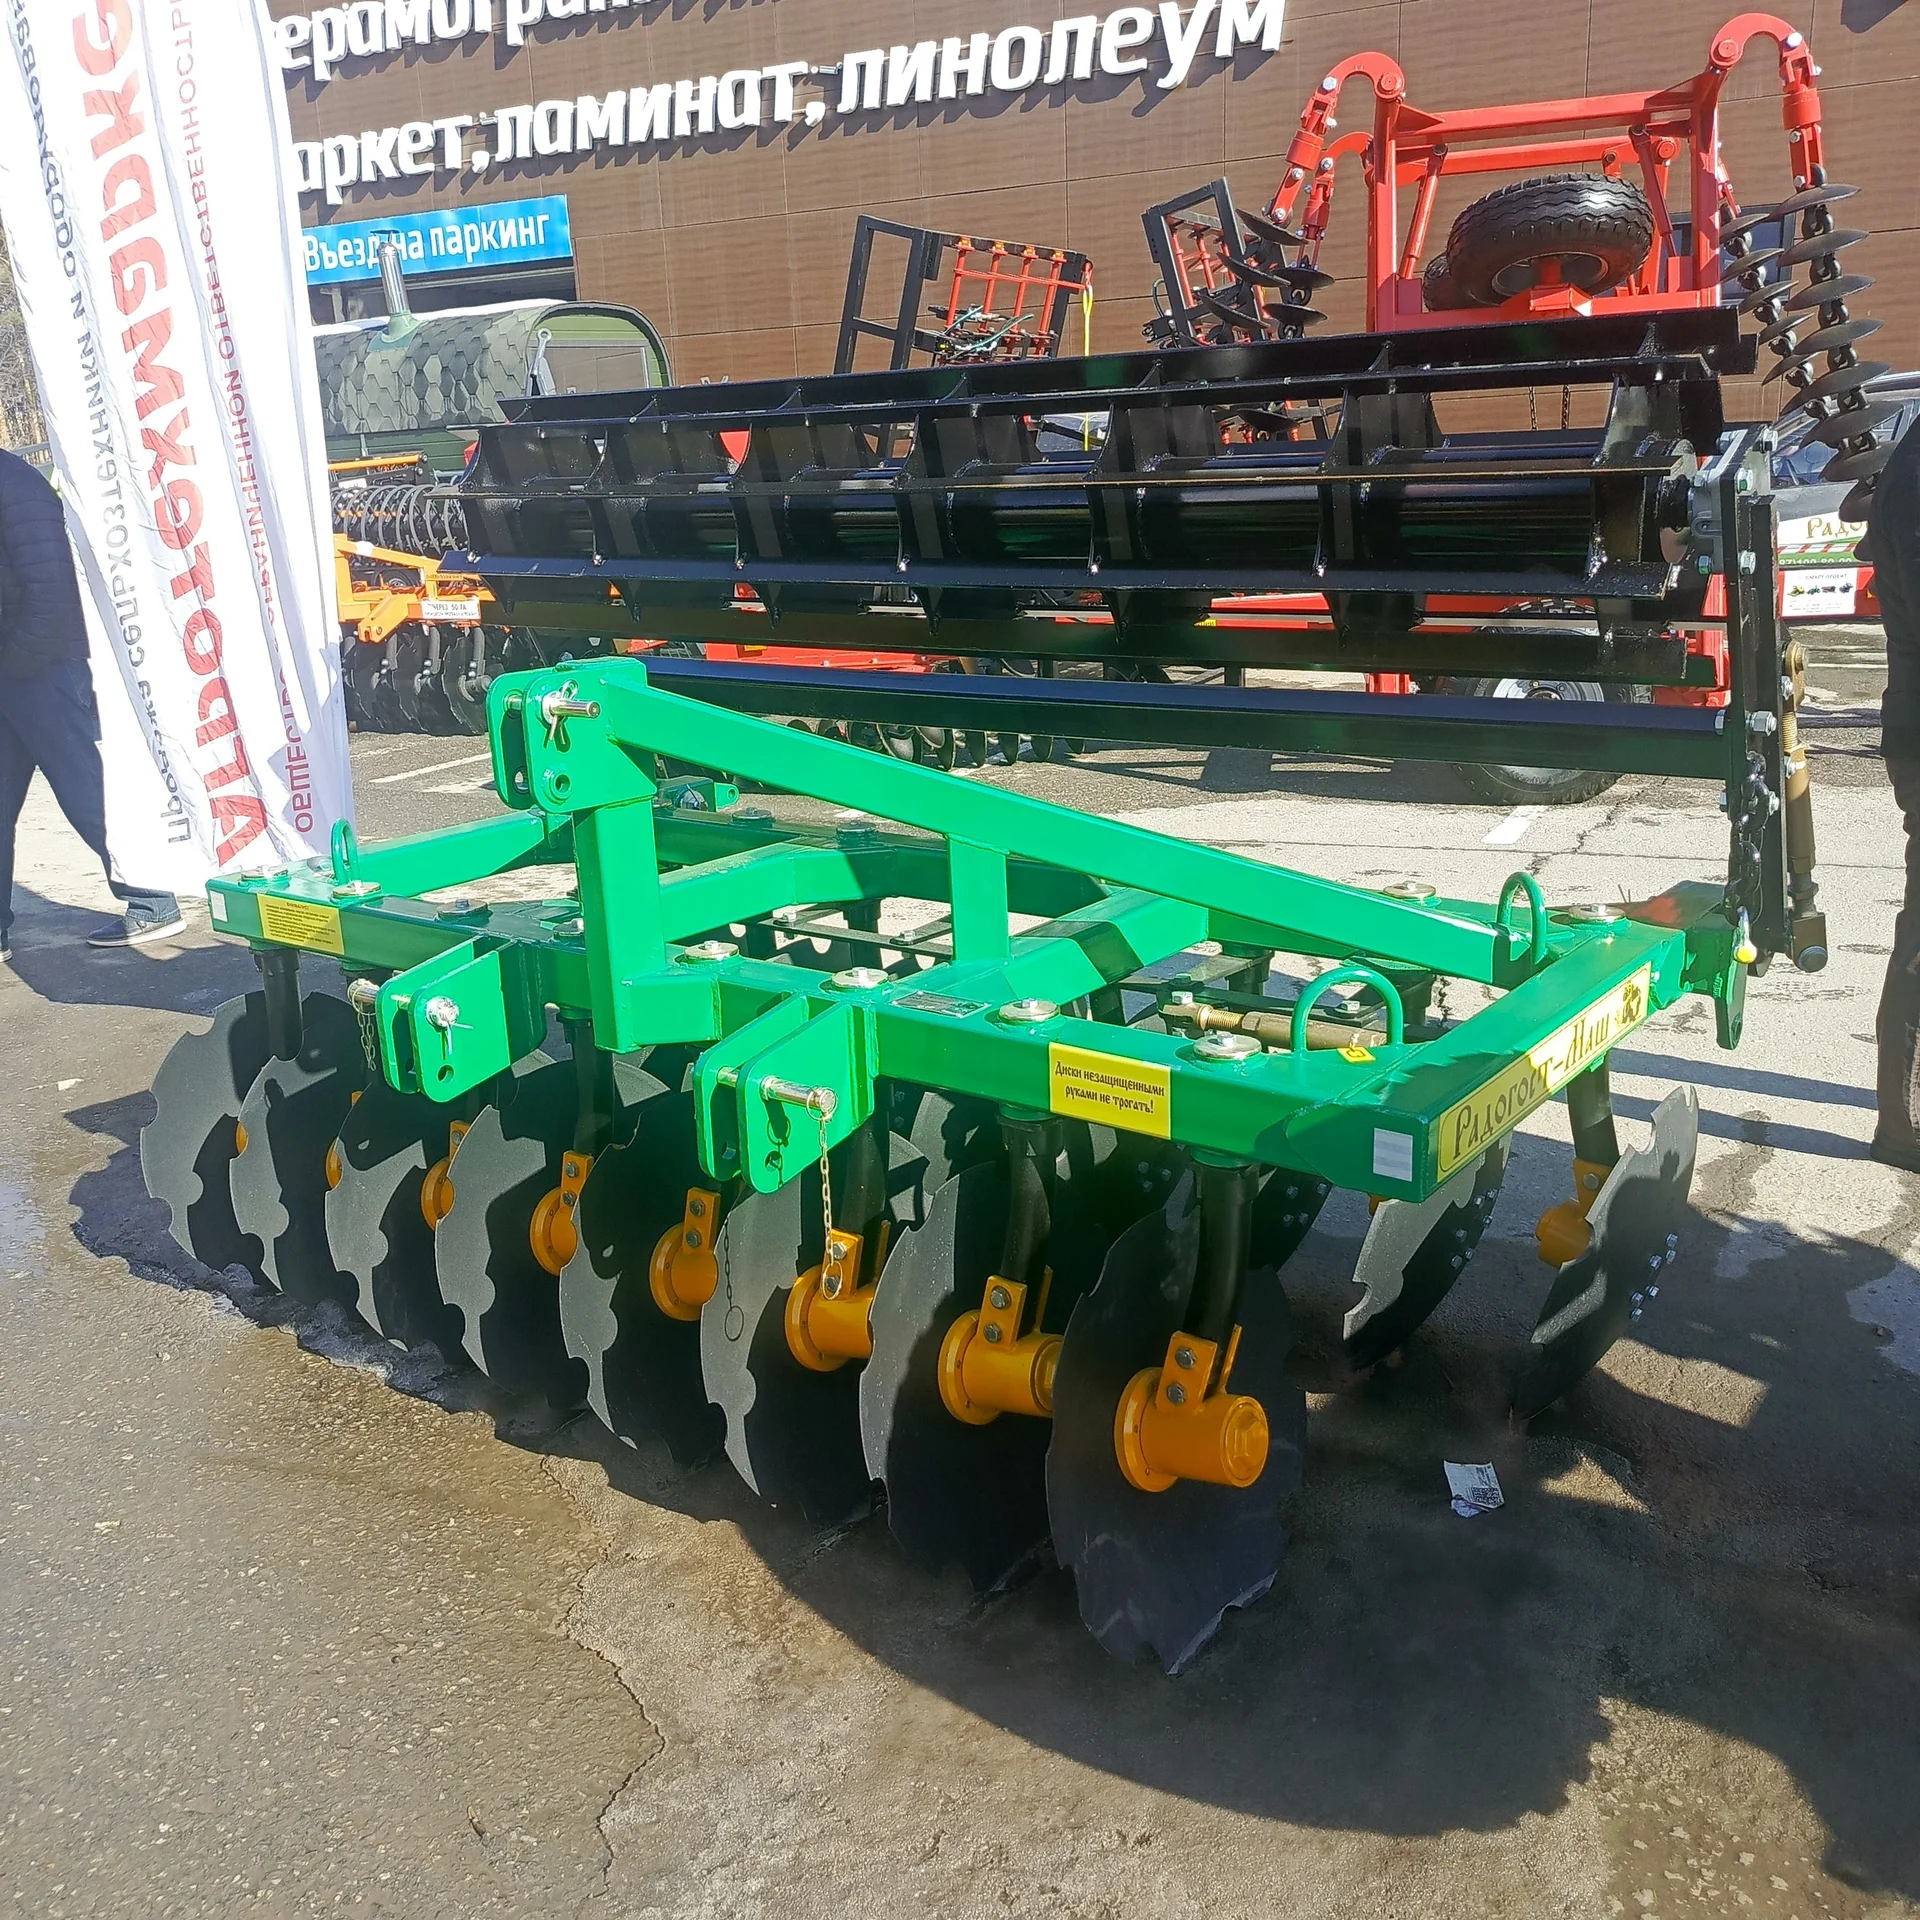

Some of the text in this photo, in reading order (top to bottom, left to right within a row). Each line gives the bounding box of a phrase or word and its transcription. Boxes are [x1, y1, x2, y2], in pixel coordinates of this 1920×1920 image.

[272, 0, 652, 81] ерамогр
[836, 0, 1286, 115] линолеум
[430, 213, 551, 263] паркинг
[1055, 1060, 1165, 1097] Диски незащищенными
[1065, 1085, 1154, 1113] руками не трогать!
